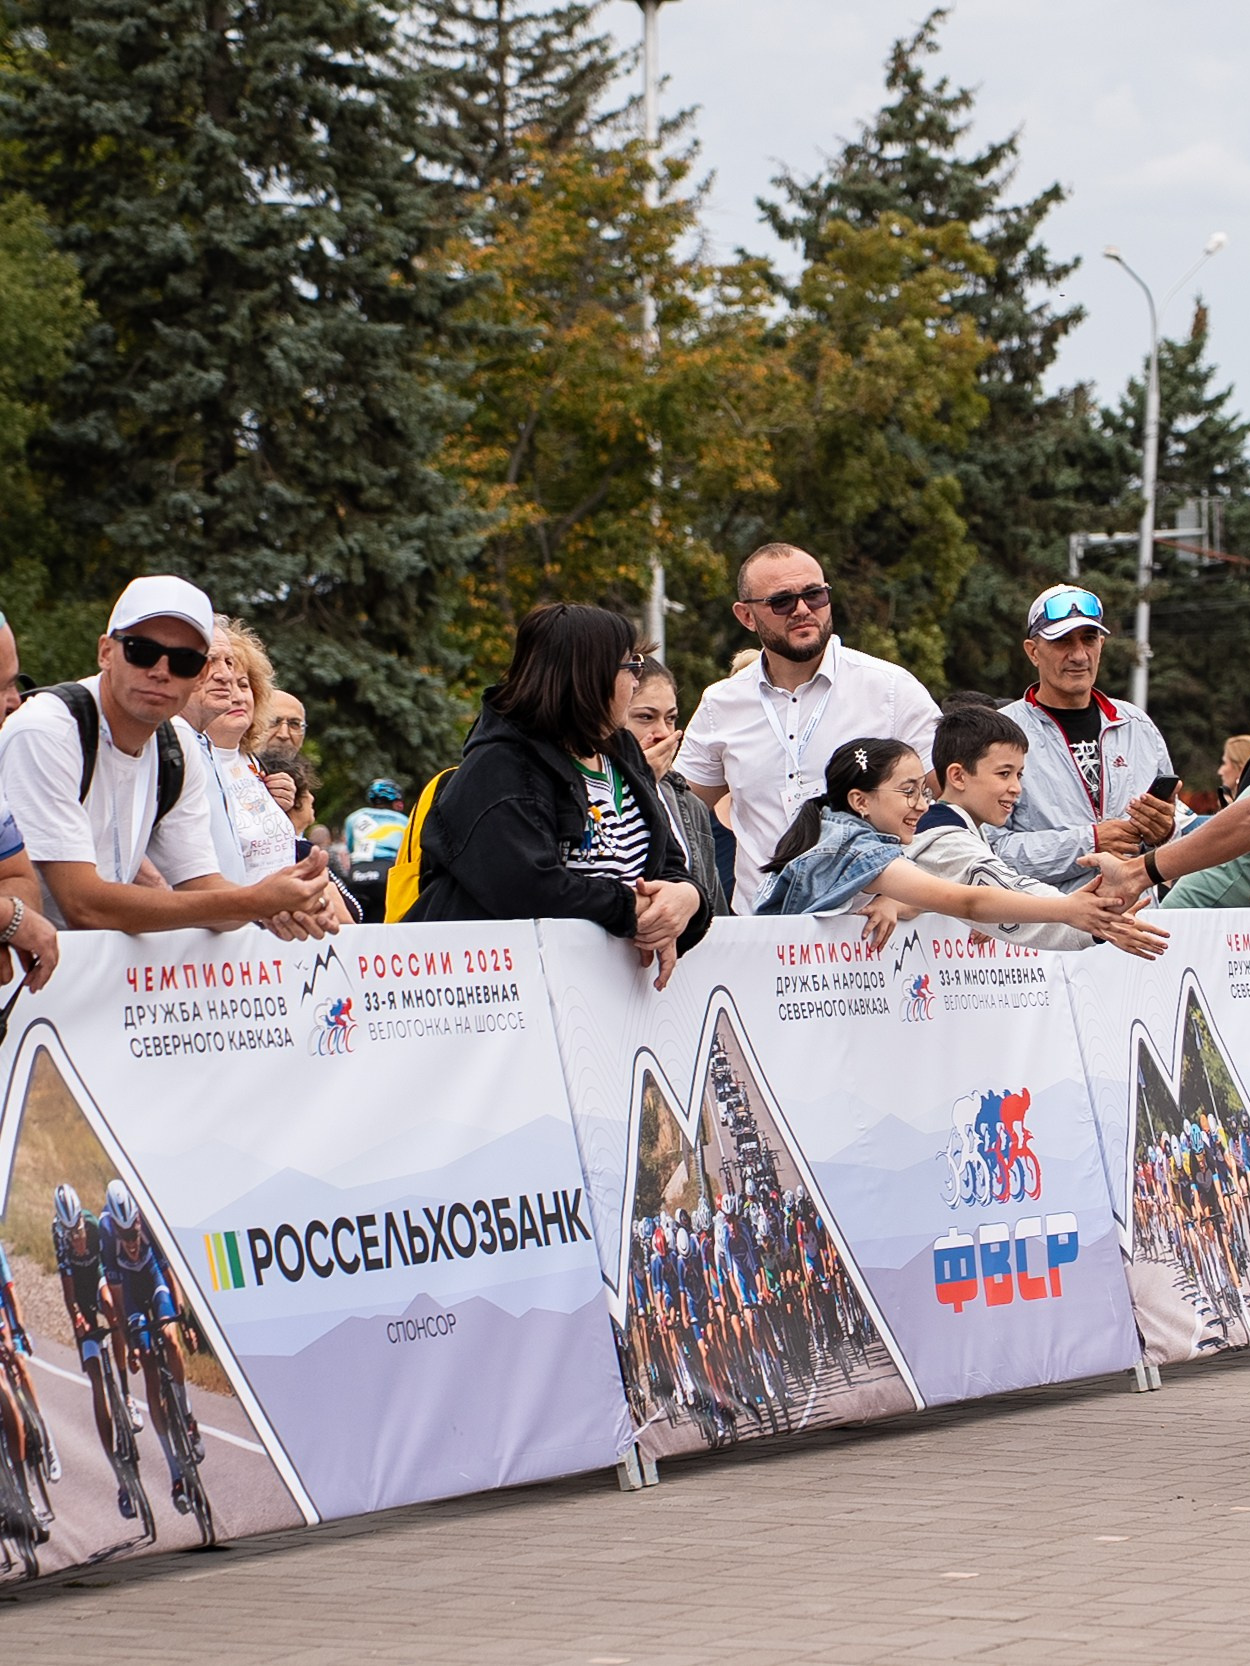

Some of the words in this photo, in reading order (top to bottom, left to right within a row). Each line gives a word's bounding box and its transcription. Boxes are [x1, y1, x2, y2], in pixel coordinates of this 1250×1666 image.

[243, 847, 271, 858] UTICO
[126, 960, 282, 993] ЧЕМПИОНАТ
[358, 952, 453, 979] РОССИИ
[464, 948, 513, 973] 2025
[776, 974, 830, 997] ДРУЖБА
[833, 971, 885, 991] НАРОДОВ
[939, 969, 961, 986] 33-Я
[964, 967, 1046, 987] МНОГОДНЕВНАЯ
[364, 991, 397, 1012] 33-Я
[401, 983, 519, 1009] МНОГОДНЕВНАЯ
[778, 999, 846, 1021] СЕВЕРНОГО
[847, 997, 890, 1016] КАВКАЗА
[944, 993, 996, 1011] ВЕЛОГОНКА
[998, 994, 1010, 1008] НА
[1012, 990, 1049, 1009] ШОССЕ
[124, 1001, 203, 1031] ДРУЖБА
[206, 996, 288, 1022] НАРОДОВ
[368, 1017, 452, 1041] ВЕЛОГОНКА
[455, 1016, 472, 1034] НА
[474, 1011, 526, 1034] ШОССЕ
[130, 1031, 225, 1058] СЕВЕРНОГО
[227, 1027, 295, 1051] КАВКАЗА
[247, 1187, 593, 1287] РОССЕЛЬХОЗБАНК
[933, 1211, 1079, 1314] ФВСР
[386, 1312, 458, 1345] СПОНСОР
